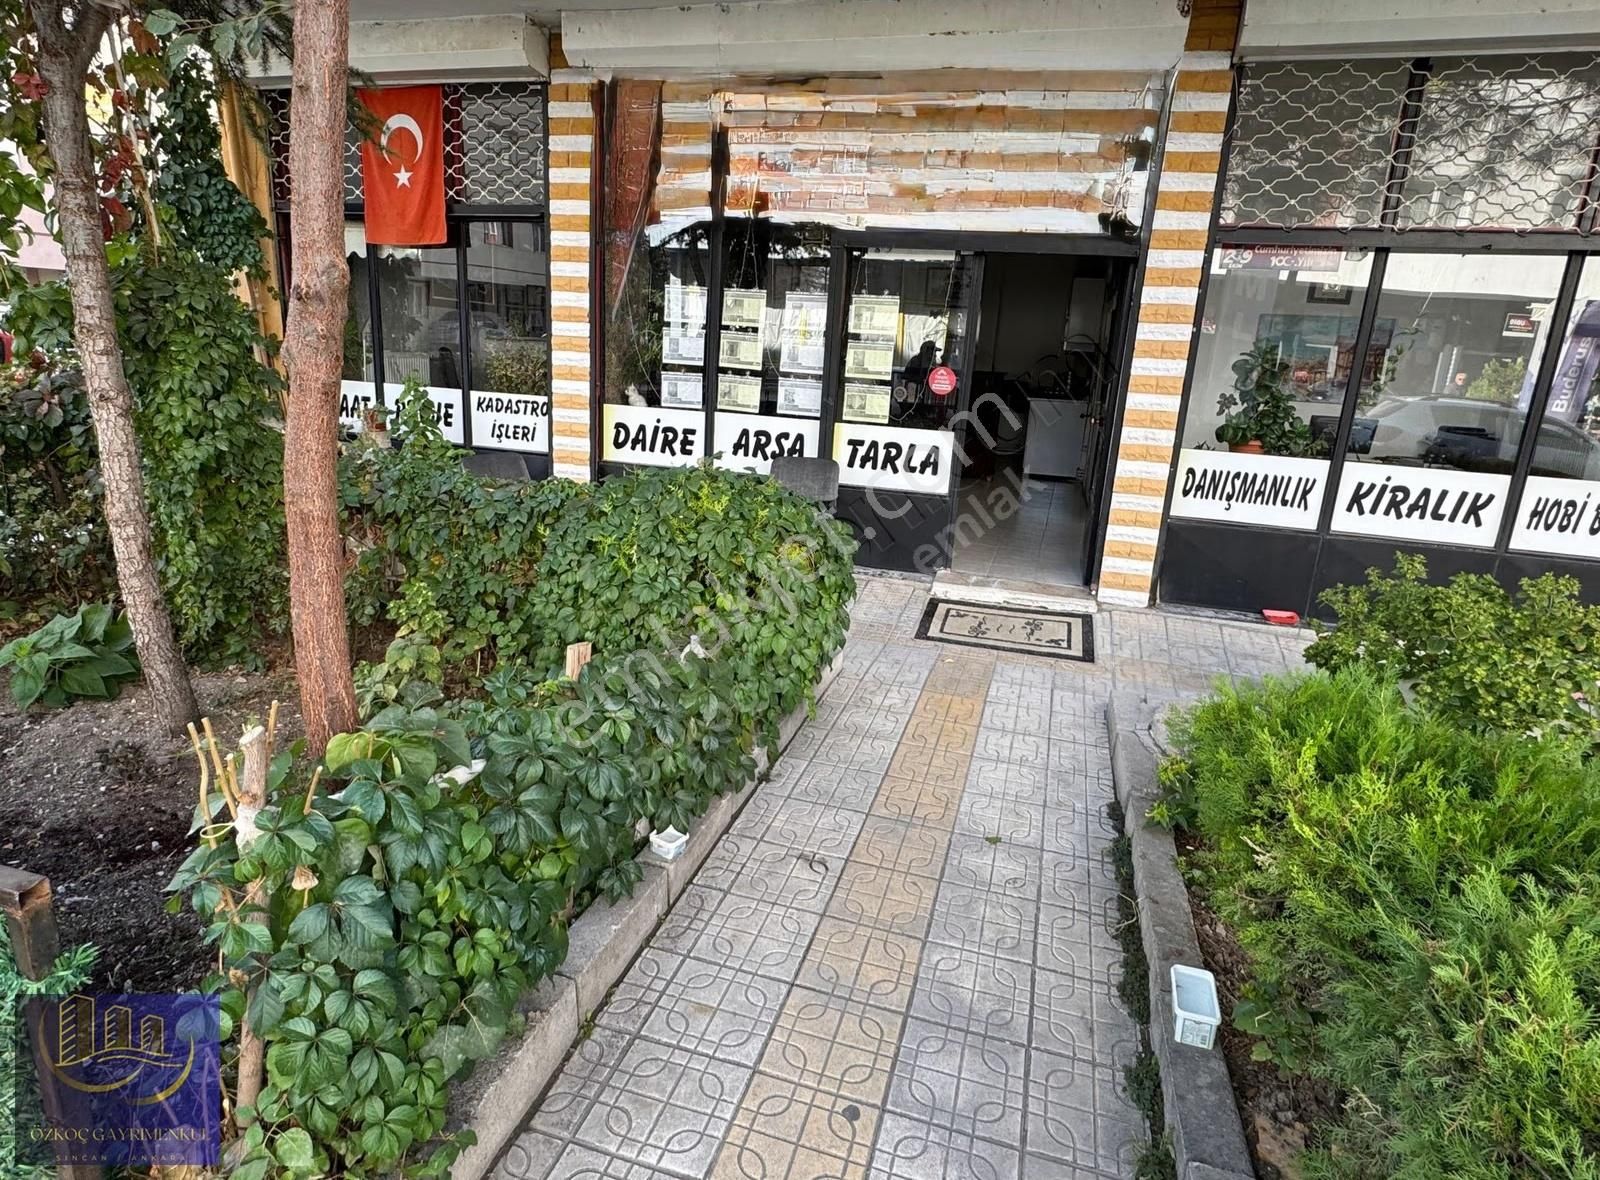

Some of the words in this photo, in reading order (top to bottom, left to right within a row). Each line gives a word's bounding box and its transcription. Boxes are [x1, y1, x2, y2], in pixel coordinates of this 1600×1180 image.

[1551, 337, 1593, 413] Buderus
[476, 396, 549, 417] KADASTRO
[490, 418, 537, 444] İŞLERİ
[613, 417, 698, 457] DAİRE
[732, 427, 806, 462] ARSA
[845, 438, 940, 477] TARLA
[1181, 466, 1317, 512] DANIŞMANLIK
[1345, 474, 1497, 529] KİRALIK
[1526, 491, 1592, 535] HOBİ
